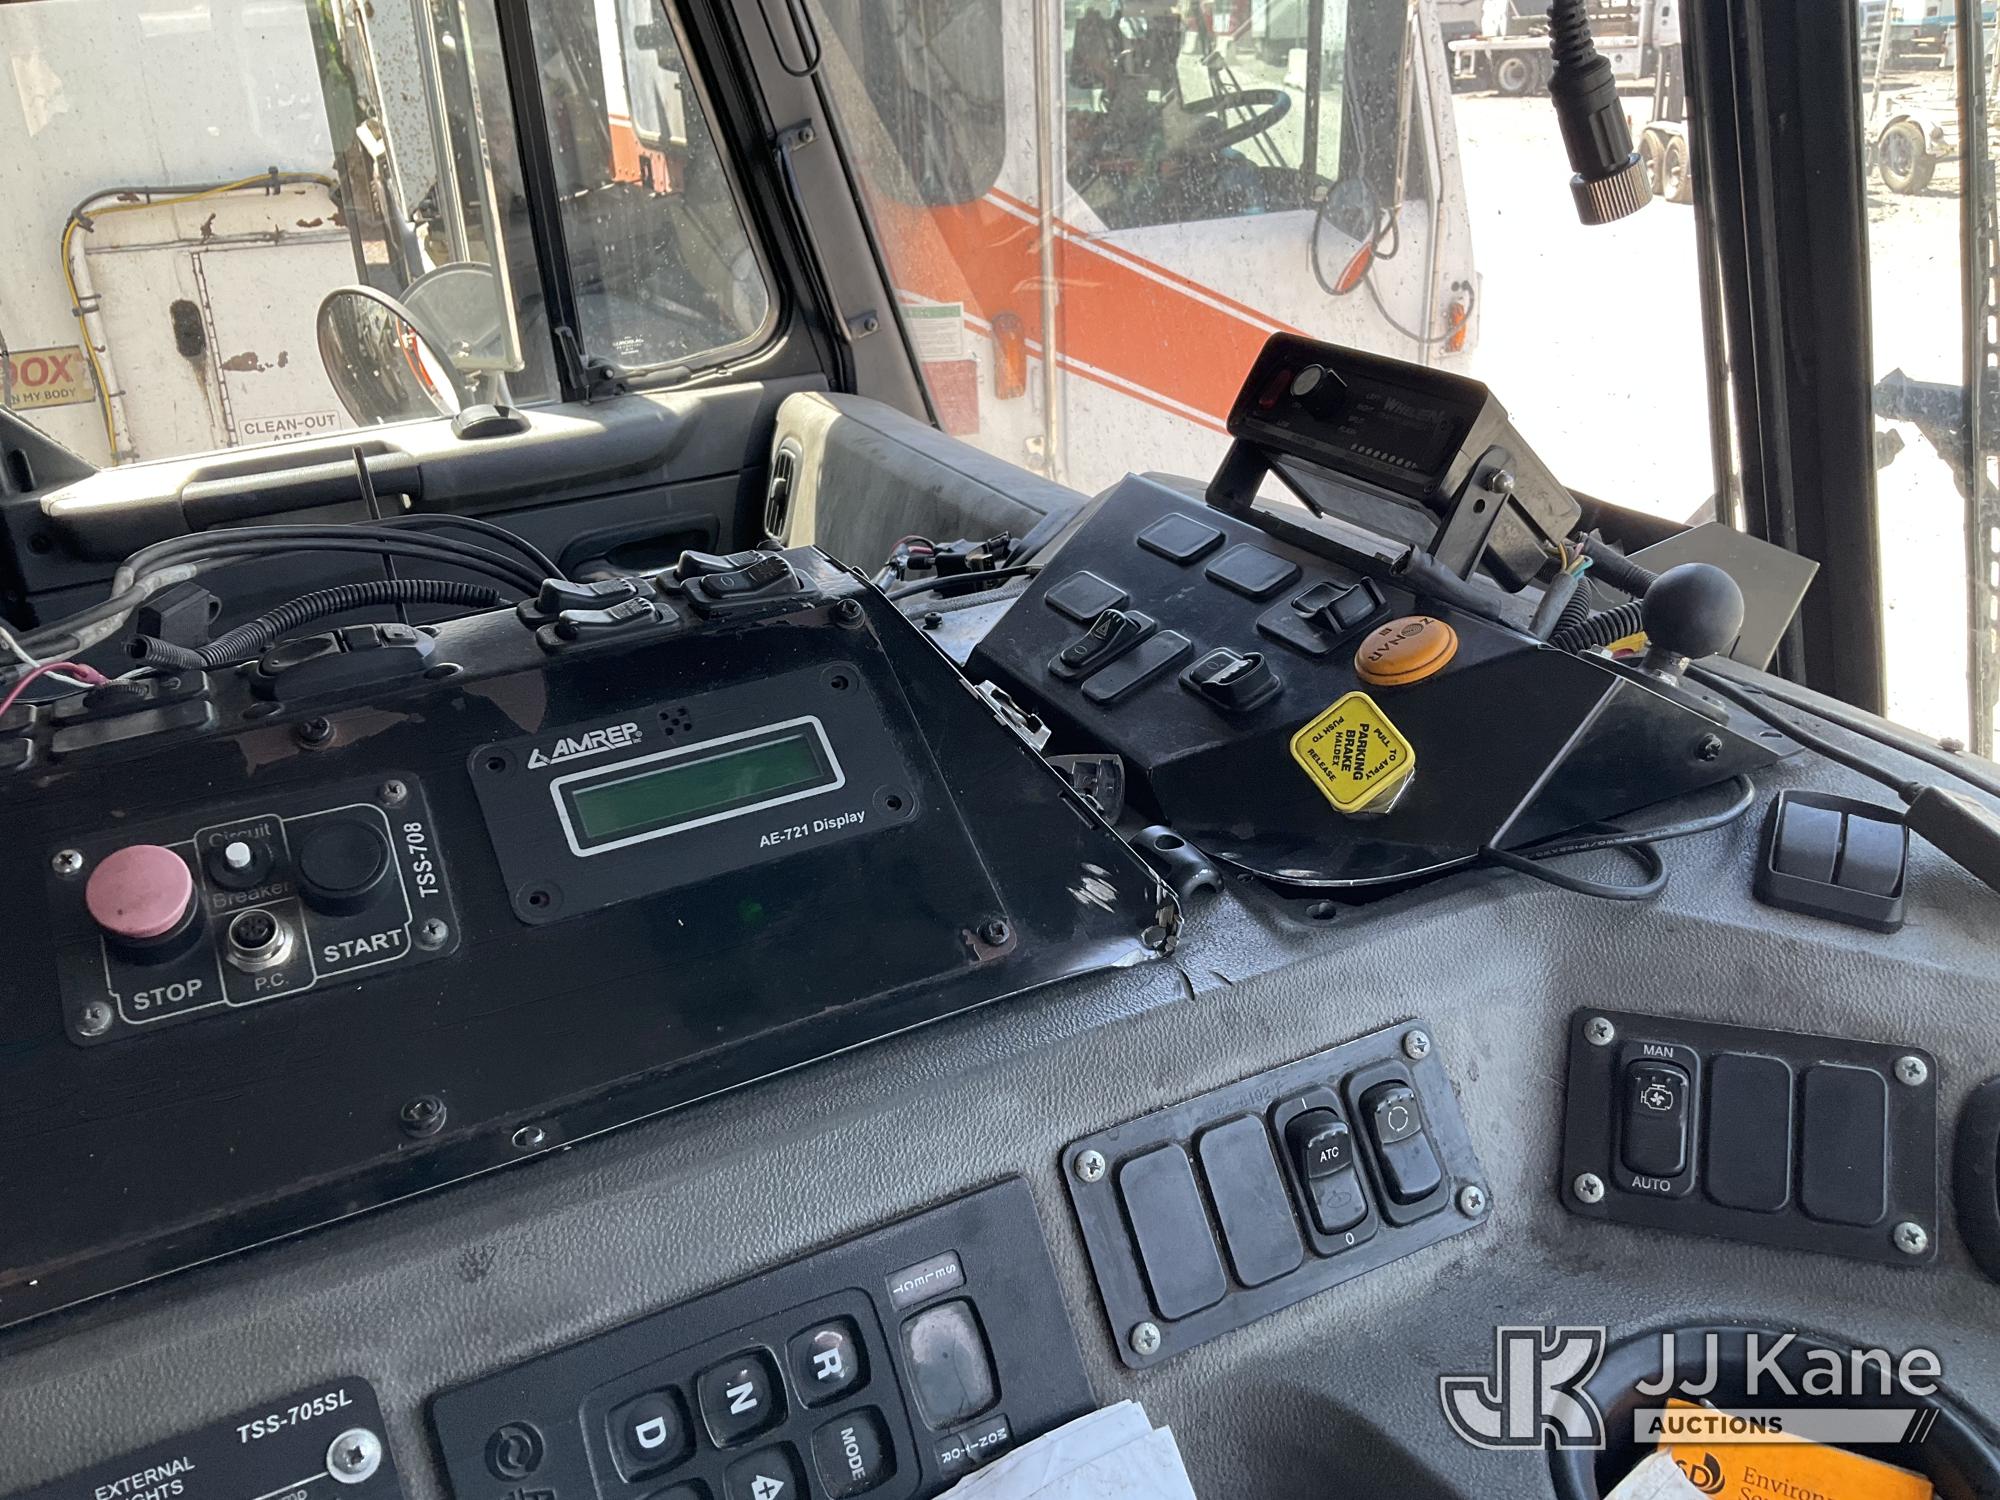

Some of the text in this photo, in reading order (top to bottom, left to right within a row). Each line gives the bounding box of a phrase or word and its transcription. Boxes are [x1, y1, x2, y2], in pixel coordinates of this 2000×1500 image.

[23, 392, 40, 402] MY
[44, 387, 76, 400] BODY
[244, 414, 336, 435] CLEAN-OUT
[1368, 617, 1435, 662] ZONAR
[551, 722, 639, 759] AMREP
[1312, 716, 1345, 743] PUSH TO
[1307, 748, 1337, 782] RELEASE
[1332, 731, 1343, 766] HALDEX
[1341, 729, 1356, 772] BRAKE
[1353, 723, 1370, 781] PARKING
[1365, 728, 1397, 780] PULL TO APPLY
[760, 810, 866, 848] AE-721 Display
[403, 822, 439, 898] TSS-708
[212, 881, 290, 909] Breaker
[323, 928, 403, 963] START
[133, 979, 202, 1010] STOP
[254, 972, 290, 991] P.C.
[1642, 1043, 1675, 1059] MAN
[1319, 1146, 1340, 1163] ATC
[1631, 1176, 1672, 1192] AUTO
[892, 1262, 957, 1295] SELECT
[813, 1347, 843, 1380] R
[726, 1381, 758, 1415] N
[236, 1388, 353, 1444] TSS-705SL
[635, 1416, 667, 1449] D
[840, 1426, 867, 1482] MODE
[941, 1427, 1009, 1464] MONITOR
[94, 1456, 196, 1500] EXTERNAL
[125, 1479, 185, 1500] GHTS
[1742, 1465, 1837, 1500] Environ
